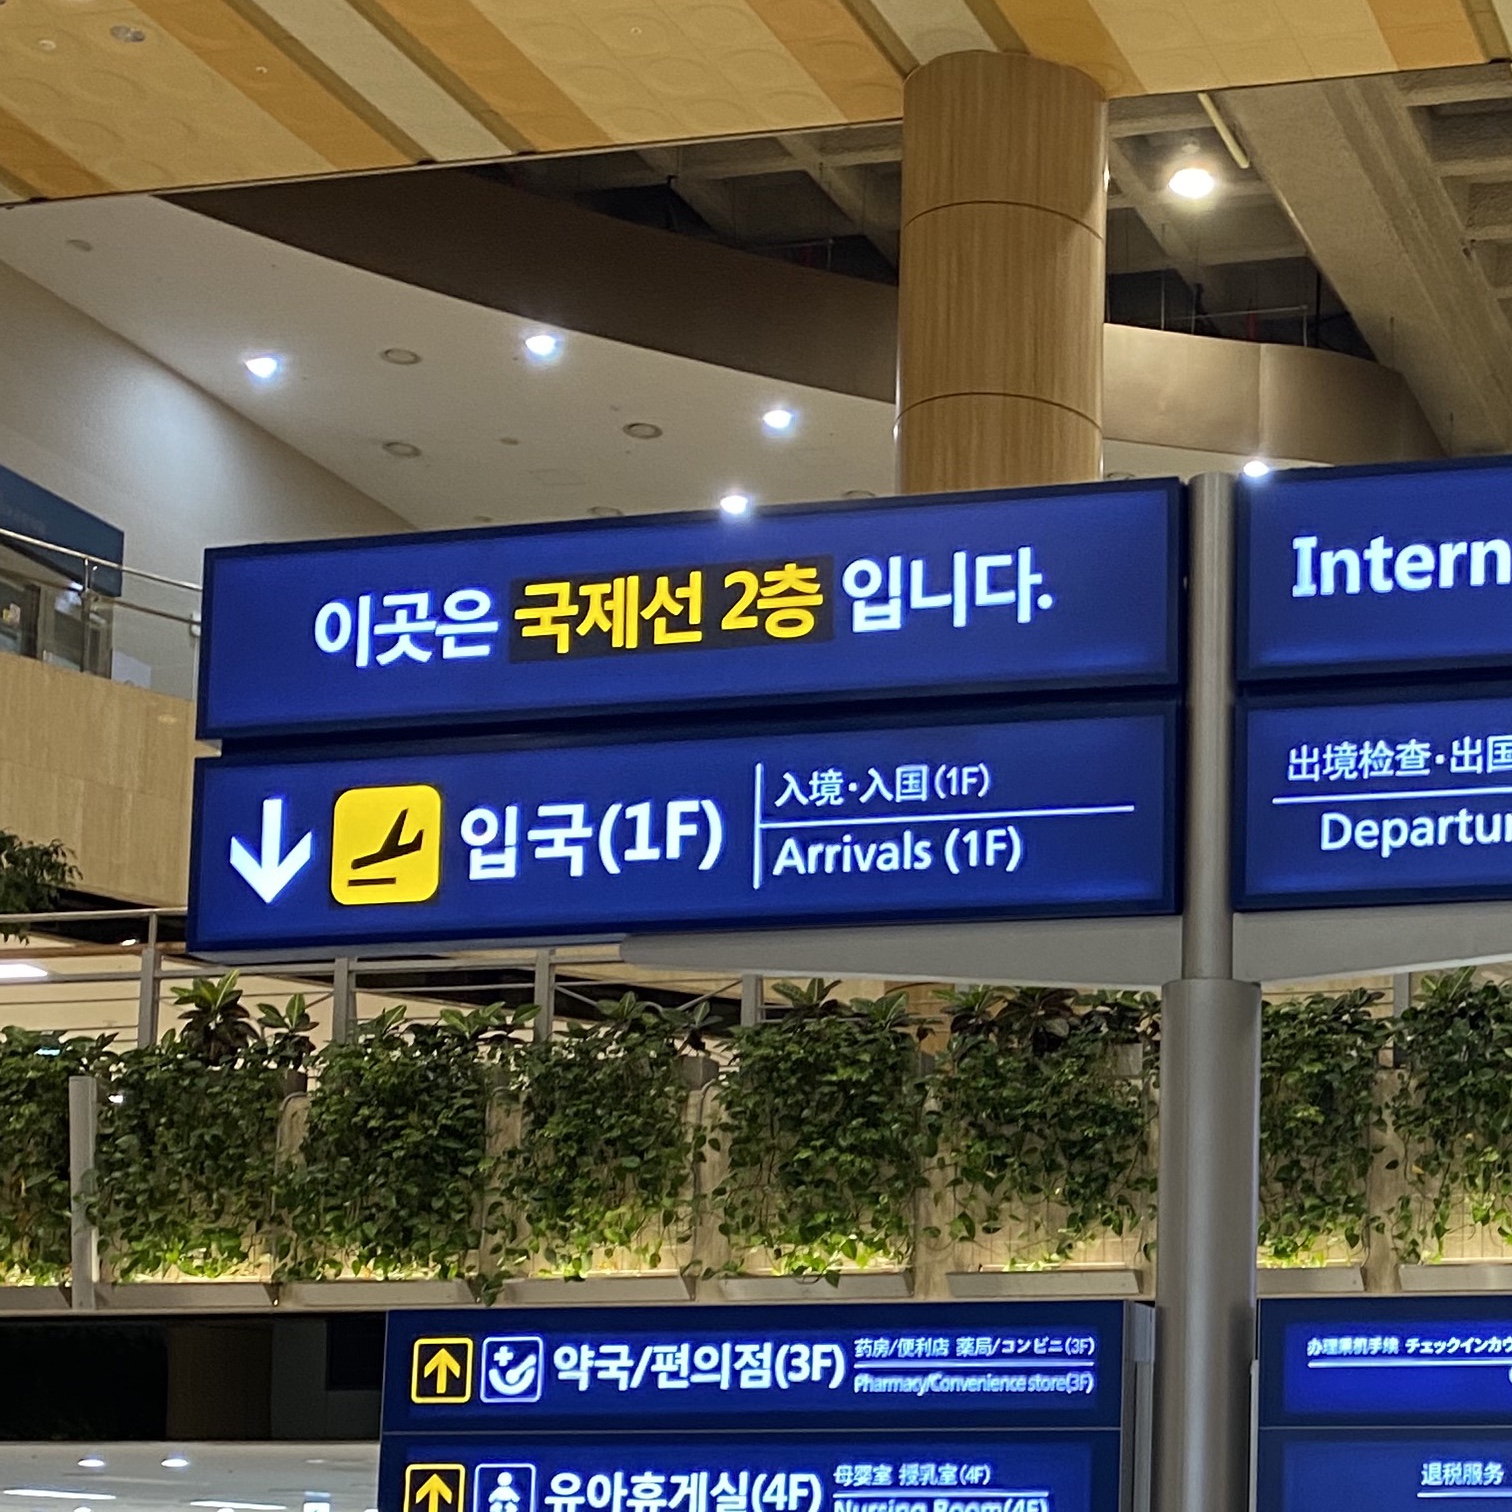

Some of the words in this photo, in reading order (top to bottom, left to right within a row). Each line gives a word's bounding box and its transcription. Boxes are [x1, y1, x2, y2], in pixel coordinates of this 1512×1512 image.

[314, 589, 499, 667] 이곳은
[514, 570, 702, 654] 국제선
[721, 563, 823, 638] 2층
[842, 546, 1053, 634] 입니다.
[460, 797, 723, 881] 입국(1F)
[773, 830, 931, 875] Arrivals
[945, 826, 1021, 874] (1F)
[553, 1341, 846, 1391] 약국/편의점(3F)
